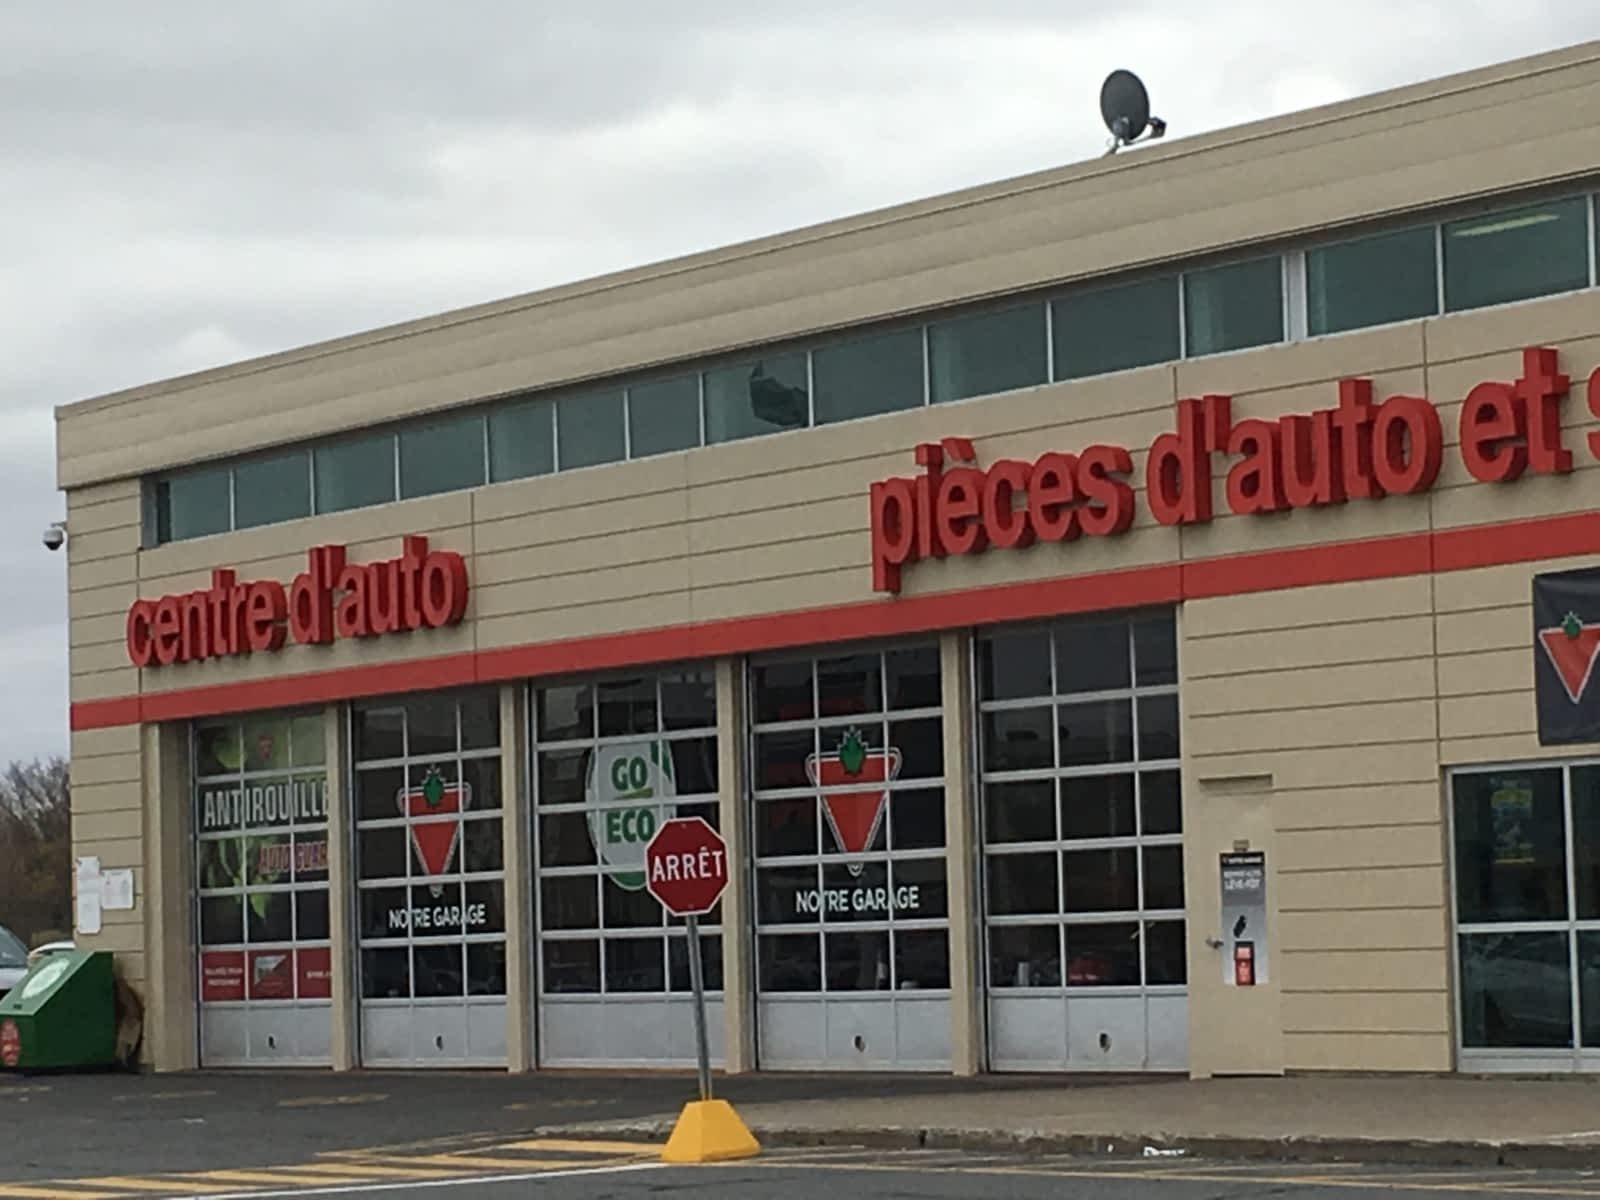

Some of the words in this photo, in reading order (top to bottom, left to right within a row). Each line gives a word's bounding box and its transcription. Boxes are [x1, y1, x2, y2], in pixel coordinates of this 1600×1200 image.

[870, 437, 1136, 594] pièces
[1146, 378, 1444, 526] d'auto
[1459, 346, 1574, 484] et
[127, 567, 289, 668] centre
[289, 535, 469, 646] d'auto
[611, 755, 649, 792] GO
[606, 808, 656, 844] ECO
[652, 845, 723, 882] ARRÊT
[388, 907, 431, 928] NOTRE
[433, 904, 486, 926] GARAGE
[796, 889, 849, 912] NOTRE
[852, 885, 919, 911] GARAGE
